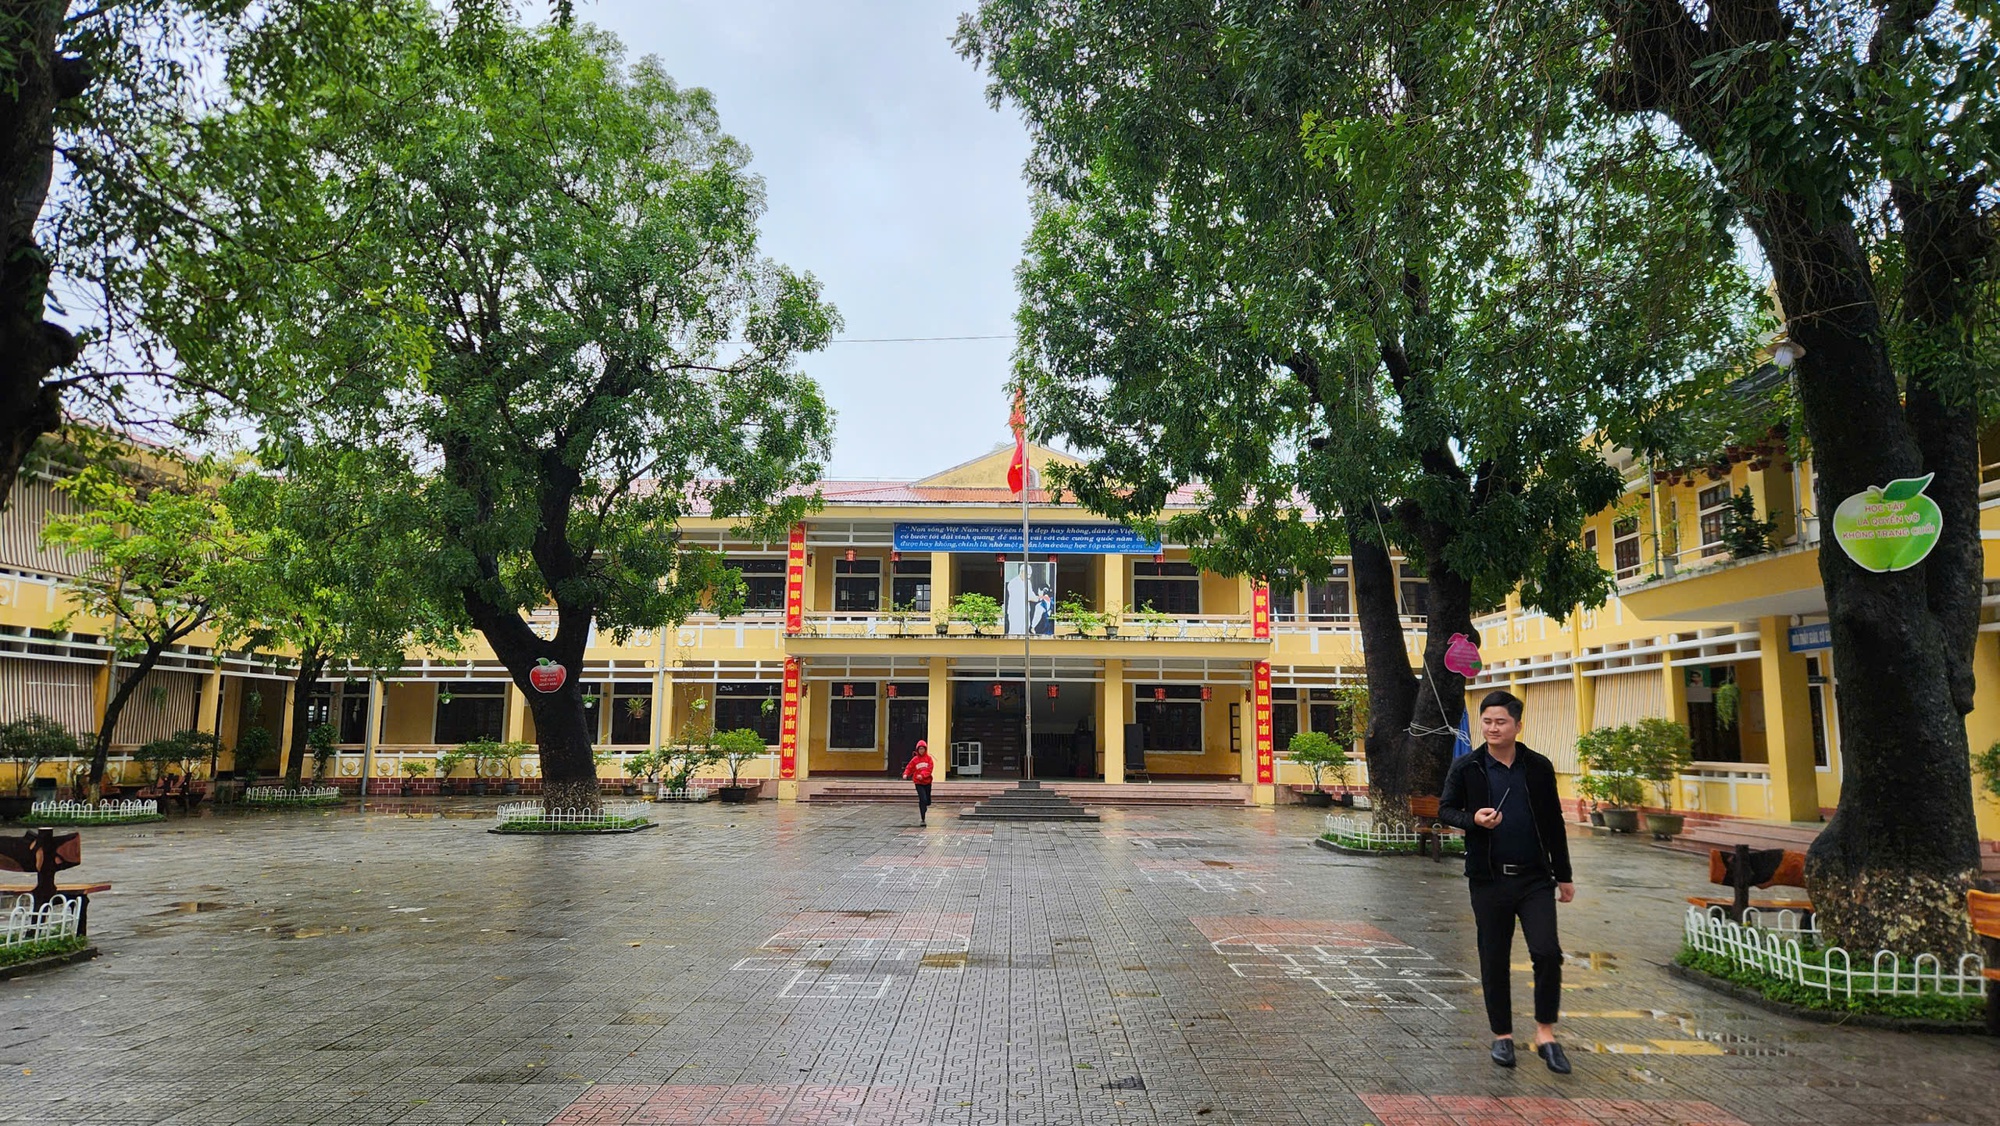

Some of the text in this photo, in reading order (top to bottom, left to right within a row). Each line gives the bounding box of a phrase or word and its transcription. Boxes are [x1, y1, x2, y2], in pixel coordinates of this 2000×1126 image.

[1905, 512, 1920, 522] VỞ
[1842, 528, 1874, 539] KHÔNG
[1877, 528, 1909, 538] TRANG
[787, 679, 796, 687] THI
[1258, 681, 1267, 689] THI
[785, 717, 795, 729] TỐT
[1259, 722, 1269, 735] TỐT
[784, 745, 794, 757] TỐT
[1260, 753, 1270, 766] TỐT
